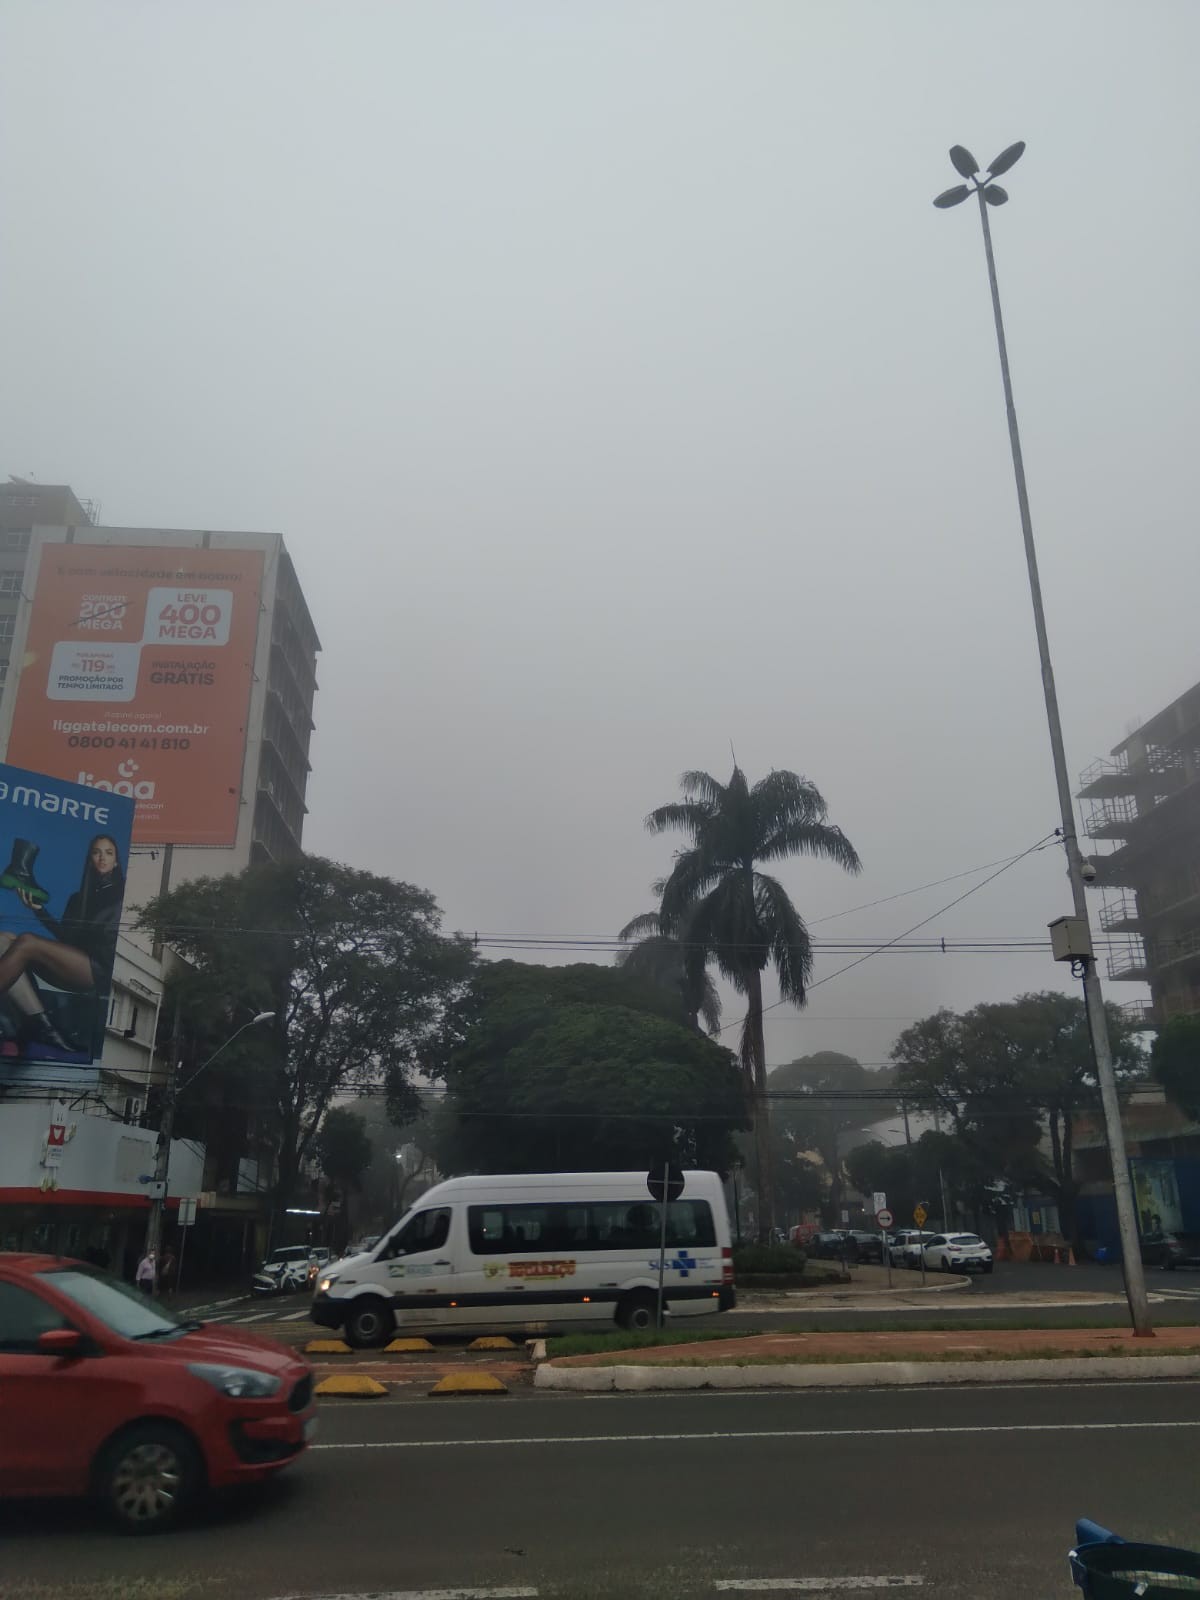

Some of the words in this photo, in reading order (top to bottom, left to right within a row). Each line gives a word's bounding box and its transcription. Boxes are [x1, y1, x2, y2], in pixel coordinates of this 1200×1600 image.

[177, 593, 208, 603] LEVE
[80, 602, 127, 619] 200
[158, 604, 222, 625] 400
[78, 619, 123, 631] MEGA
[158, 625, 217, 640] MEGA
[58, 674, 105, 685] PROMOÇÃO
[107, 676, 124, 684] POR
[149, 669, 215, 687] GRÁTIS
[57, 682, 86, 690] TEMPO
[53, 719, 209, 735] liggatelecom.com.br
[68, 735, 115, 749] 0800
